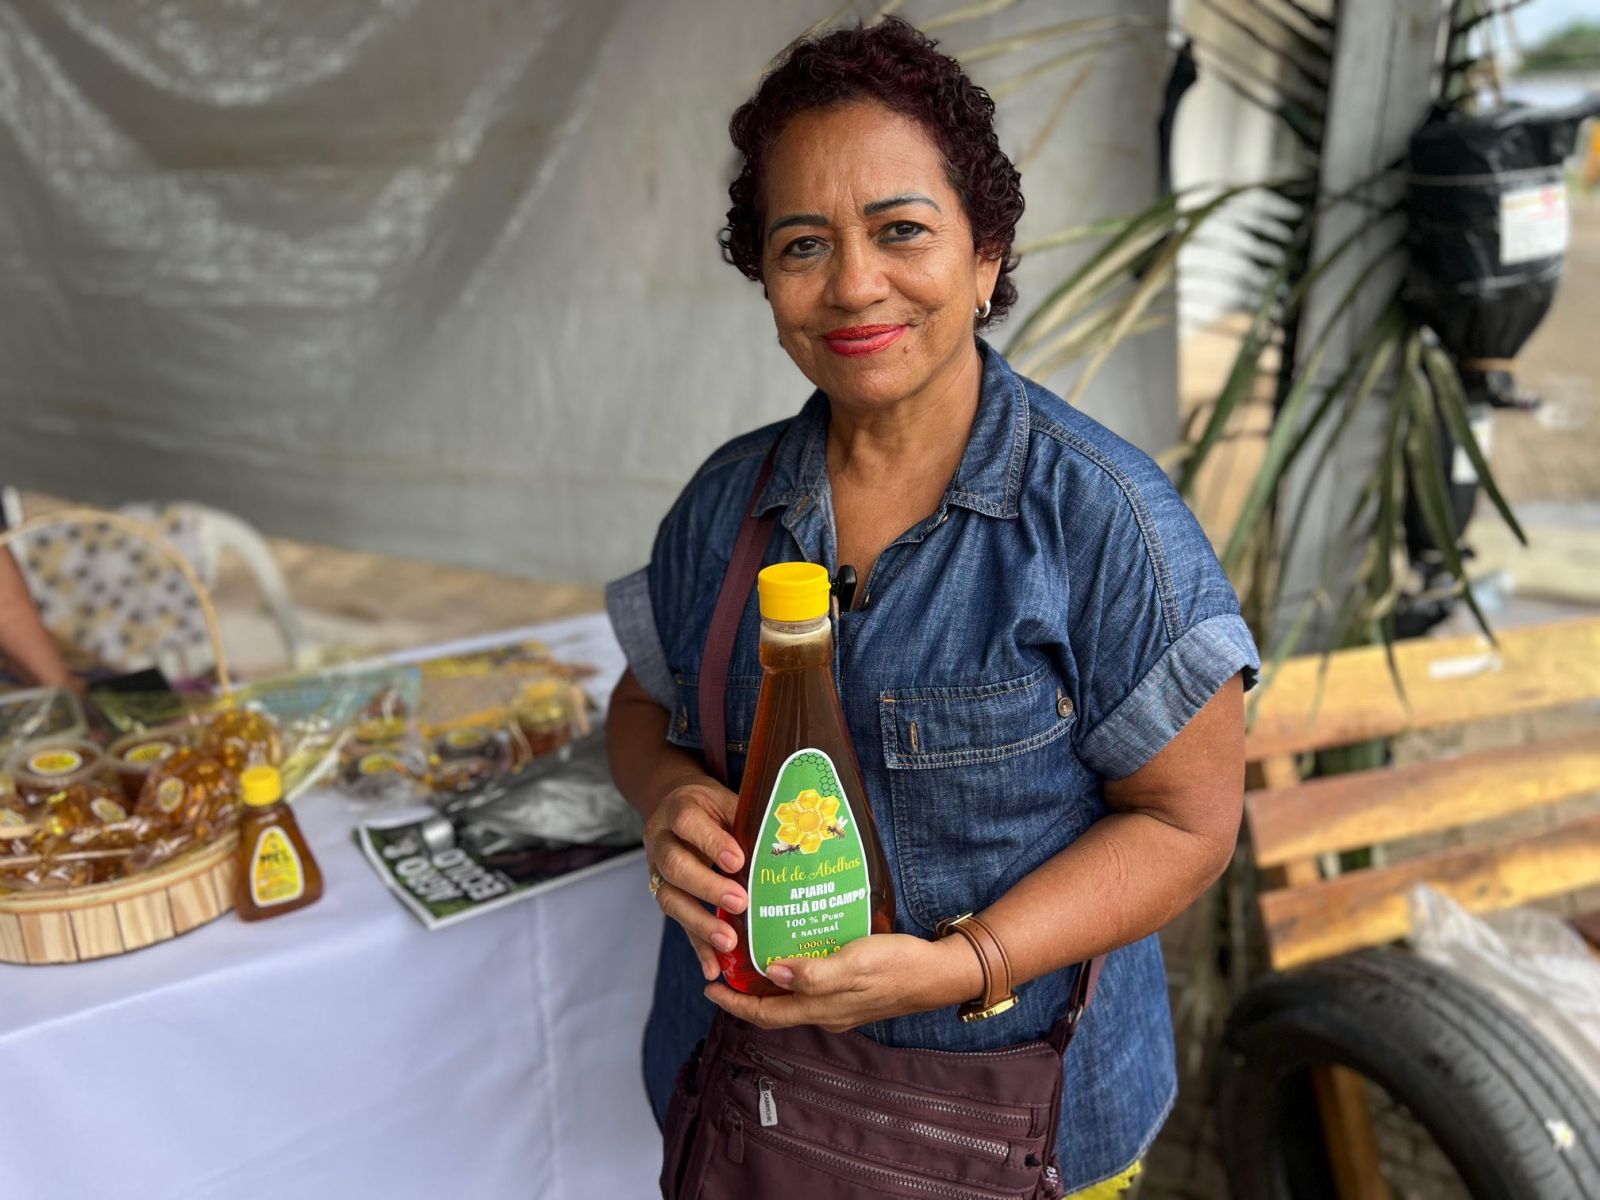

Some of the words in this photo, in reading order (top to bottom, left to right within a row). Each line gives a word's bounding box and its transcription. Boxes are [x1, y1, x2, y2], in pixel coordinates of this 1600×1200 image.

[761, 867, 787, 884] Mel
[790, 865, 807, 882] de
[809, 856, 861, 881] Abelhas
[790, 881, 835, 900] APIARIO
[759, 900, 810, 918] HORTELÃ
[811, 898, 828, 912] DO
[828, 887, 866, 909] CAMPO
[786, 918, 806, 928] 100
[809, 915, 819, 926] %
[799, 941, 823, 950] 1000
